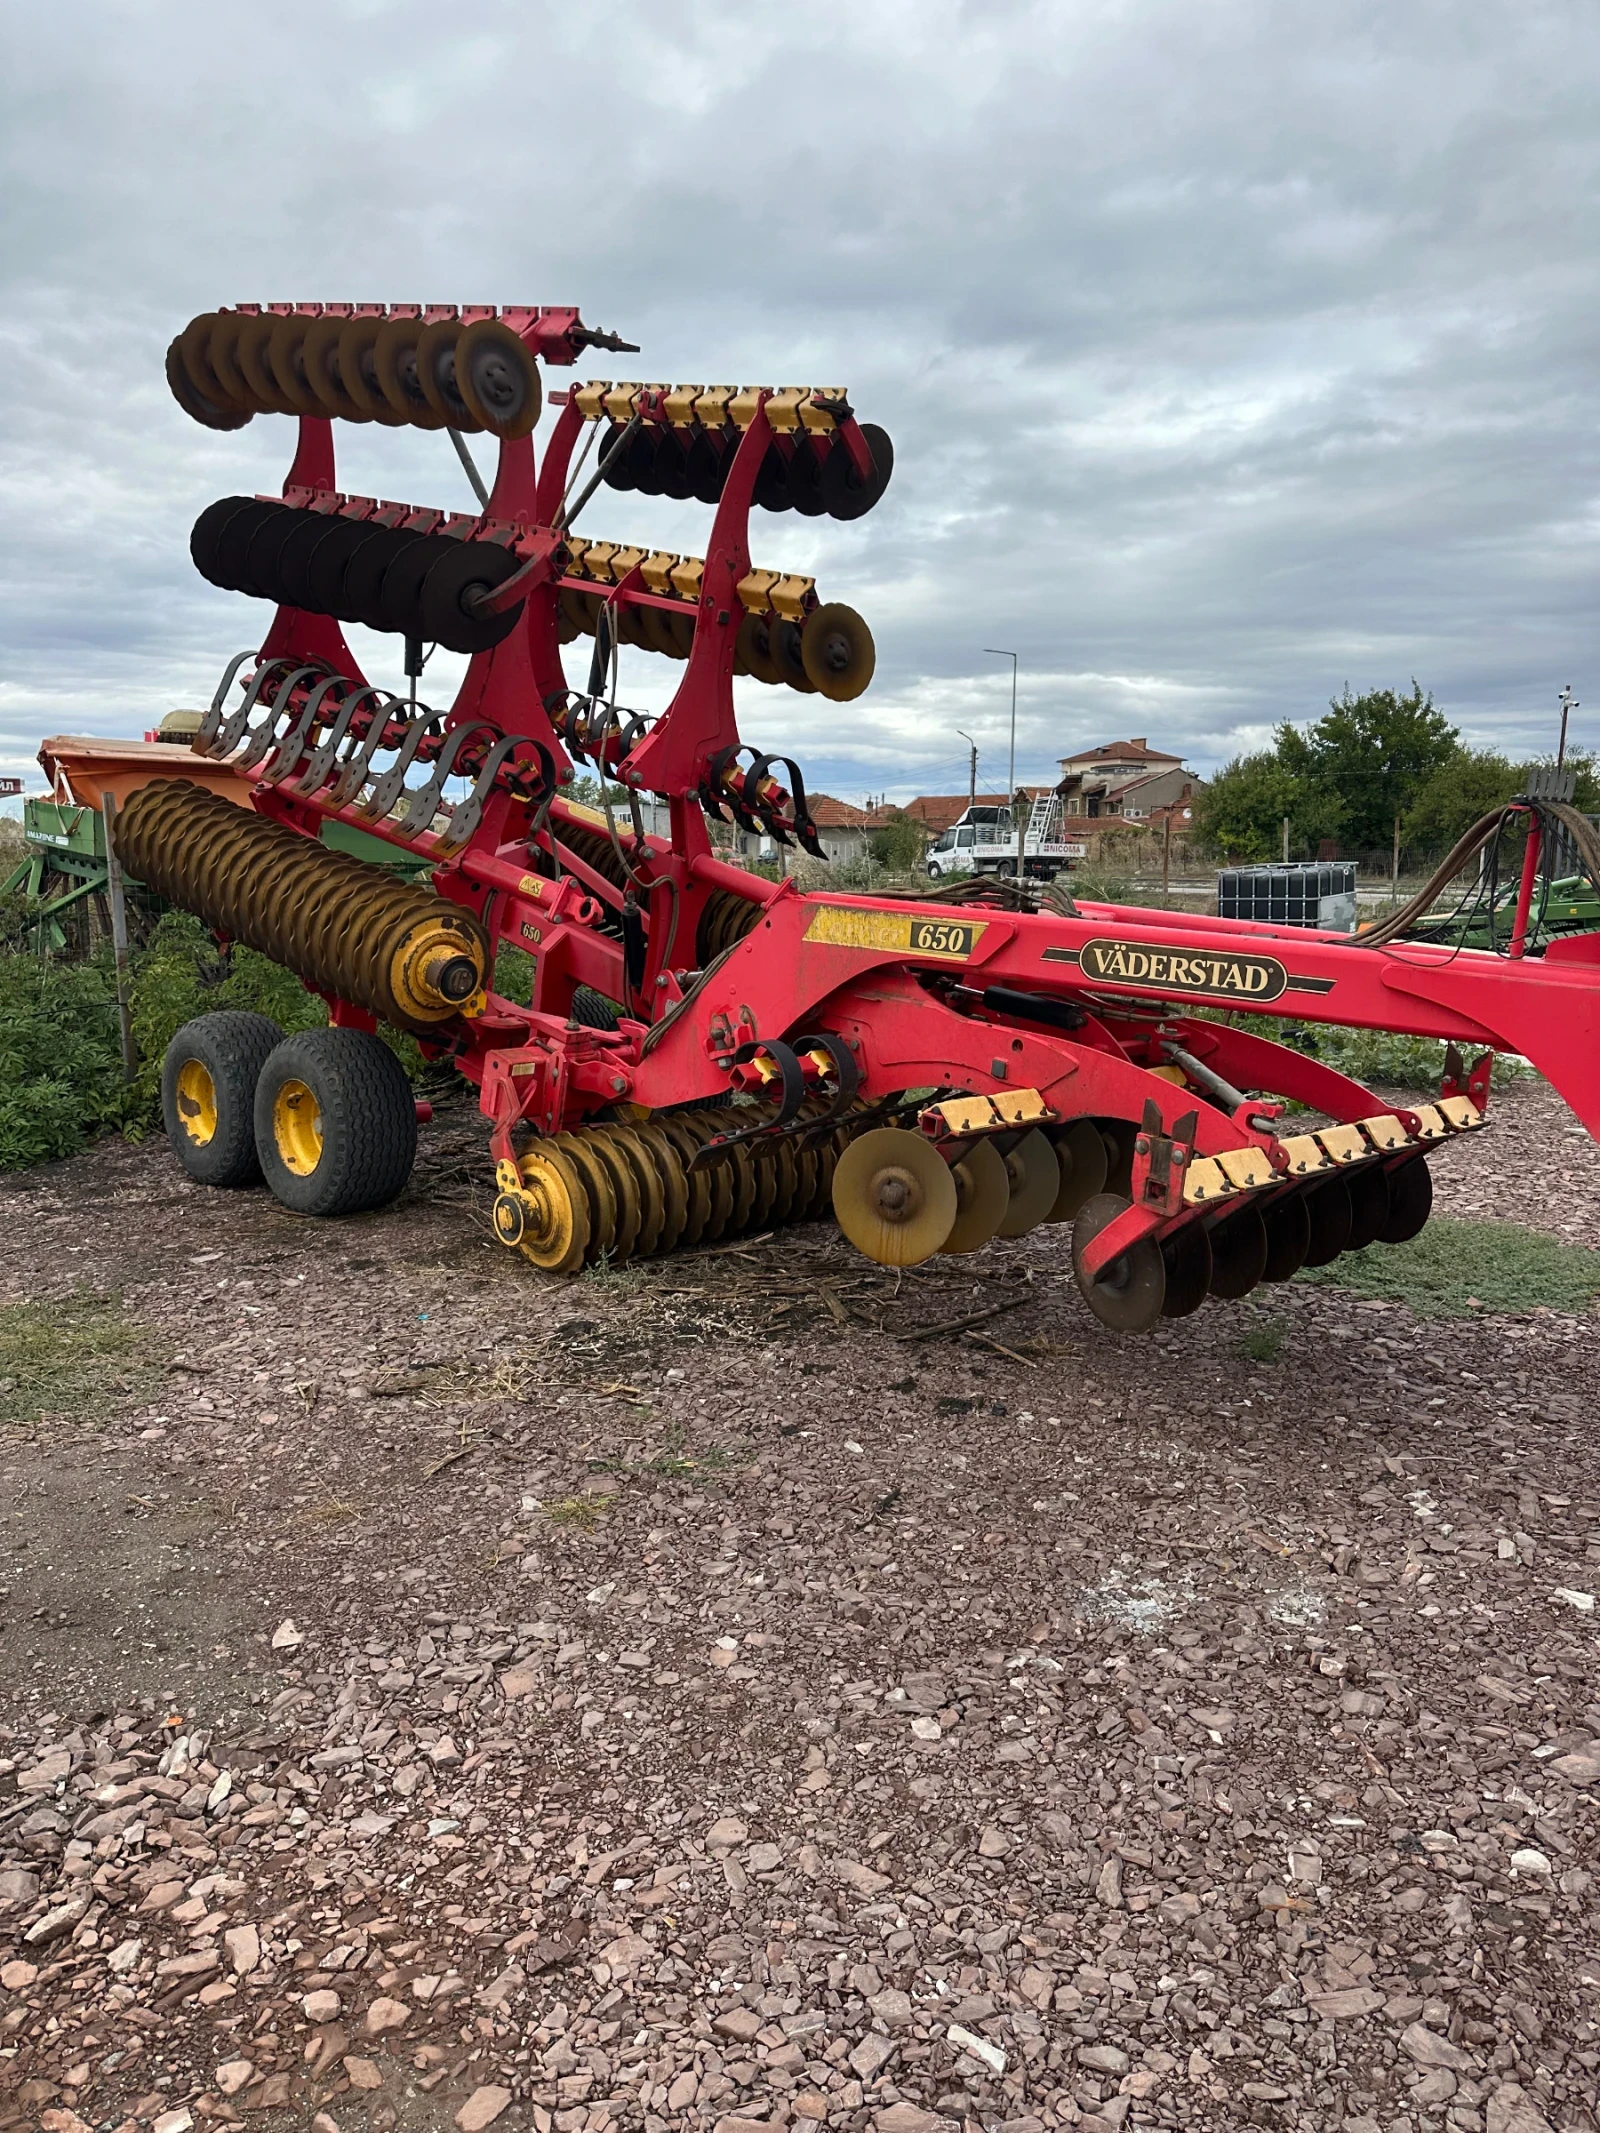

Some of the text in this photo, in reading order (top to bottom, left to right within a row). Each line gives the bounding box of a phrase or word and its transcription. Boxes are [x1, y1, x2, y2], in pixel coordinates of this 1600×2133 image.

[1050, 845, 1081, 853] NICOMA
[522, 923, 541, 943] 650
[917, 924, 964, 952] 650
[1093, 944, 1269, 992] VÄDERSTAD
